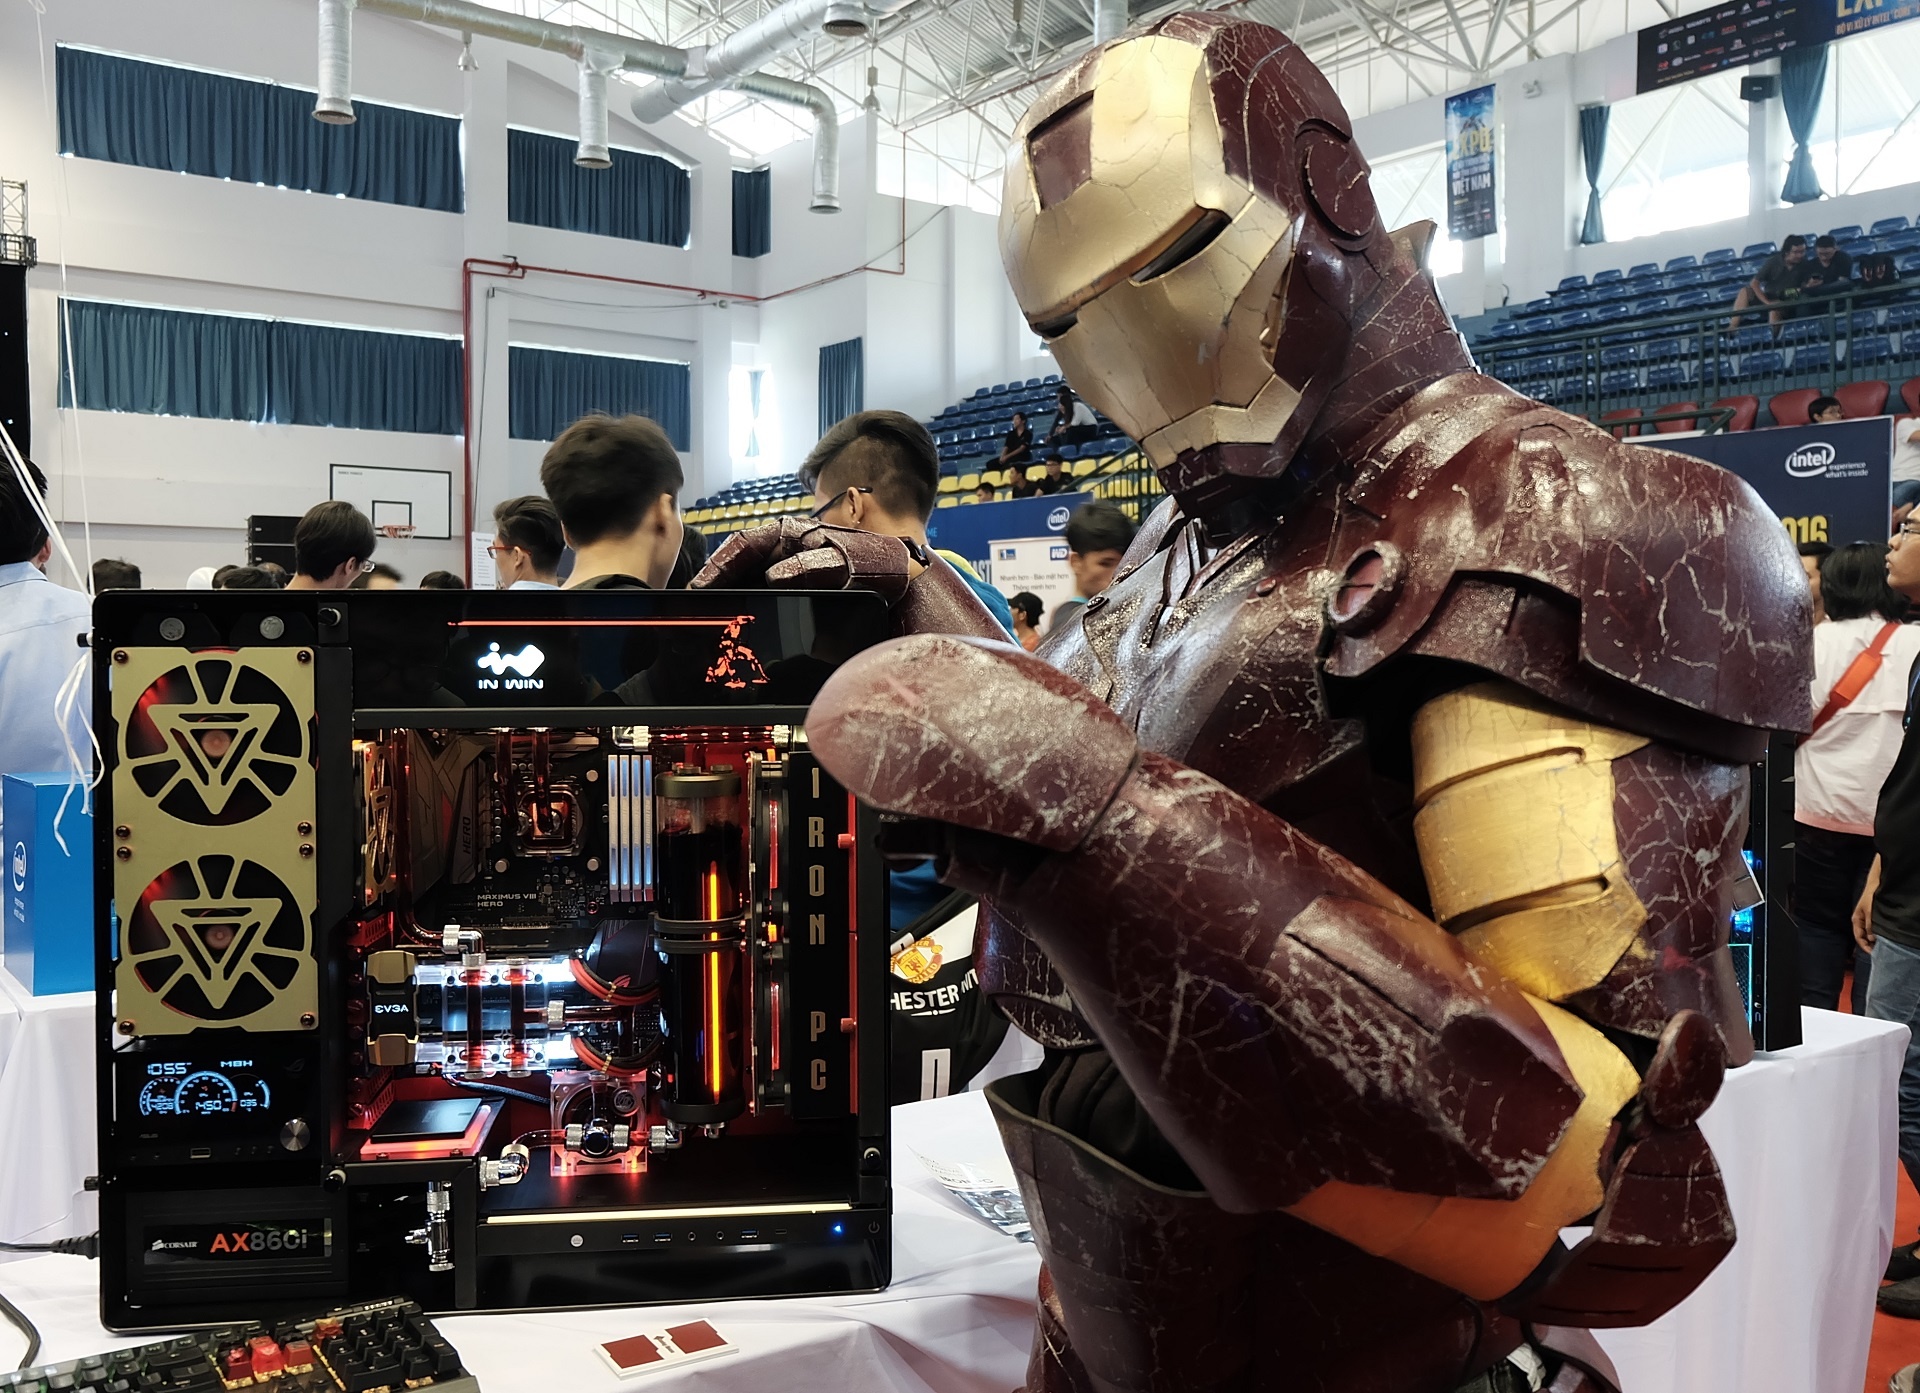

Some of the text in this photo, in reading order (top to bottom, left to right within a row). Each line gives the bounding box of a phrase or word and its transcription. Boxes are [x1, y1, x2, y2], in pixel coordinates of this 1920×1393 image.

[1471, 172, 1491, 191] NAM
[1829, 462, 1867, 470] experience
[1848, 469, 1869, 477] inside
[1051, 548, 1068, 558] WD
[478, 679, 544, 690] IN WIN
[462, 816, 471, 855] HERO
[374, 1004, 409, 1013] EVGA
[163, 1228, 308, 1253] CORSAIR AX860i
